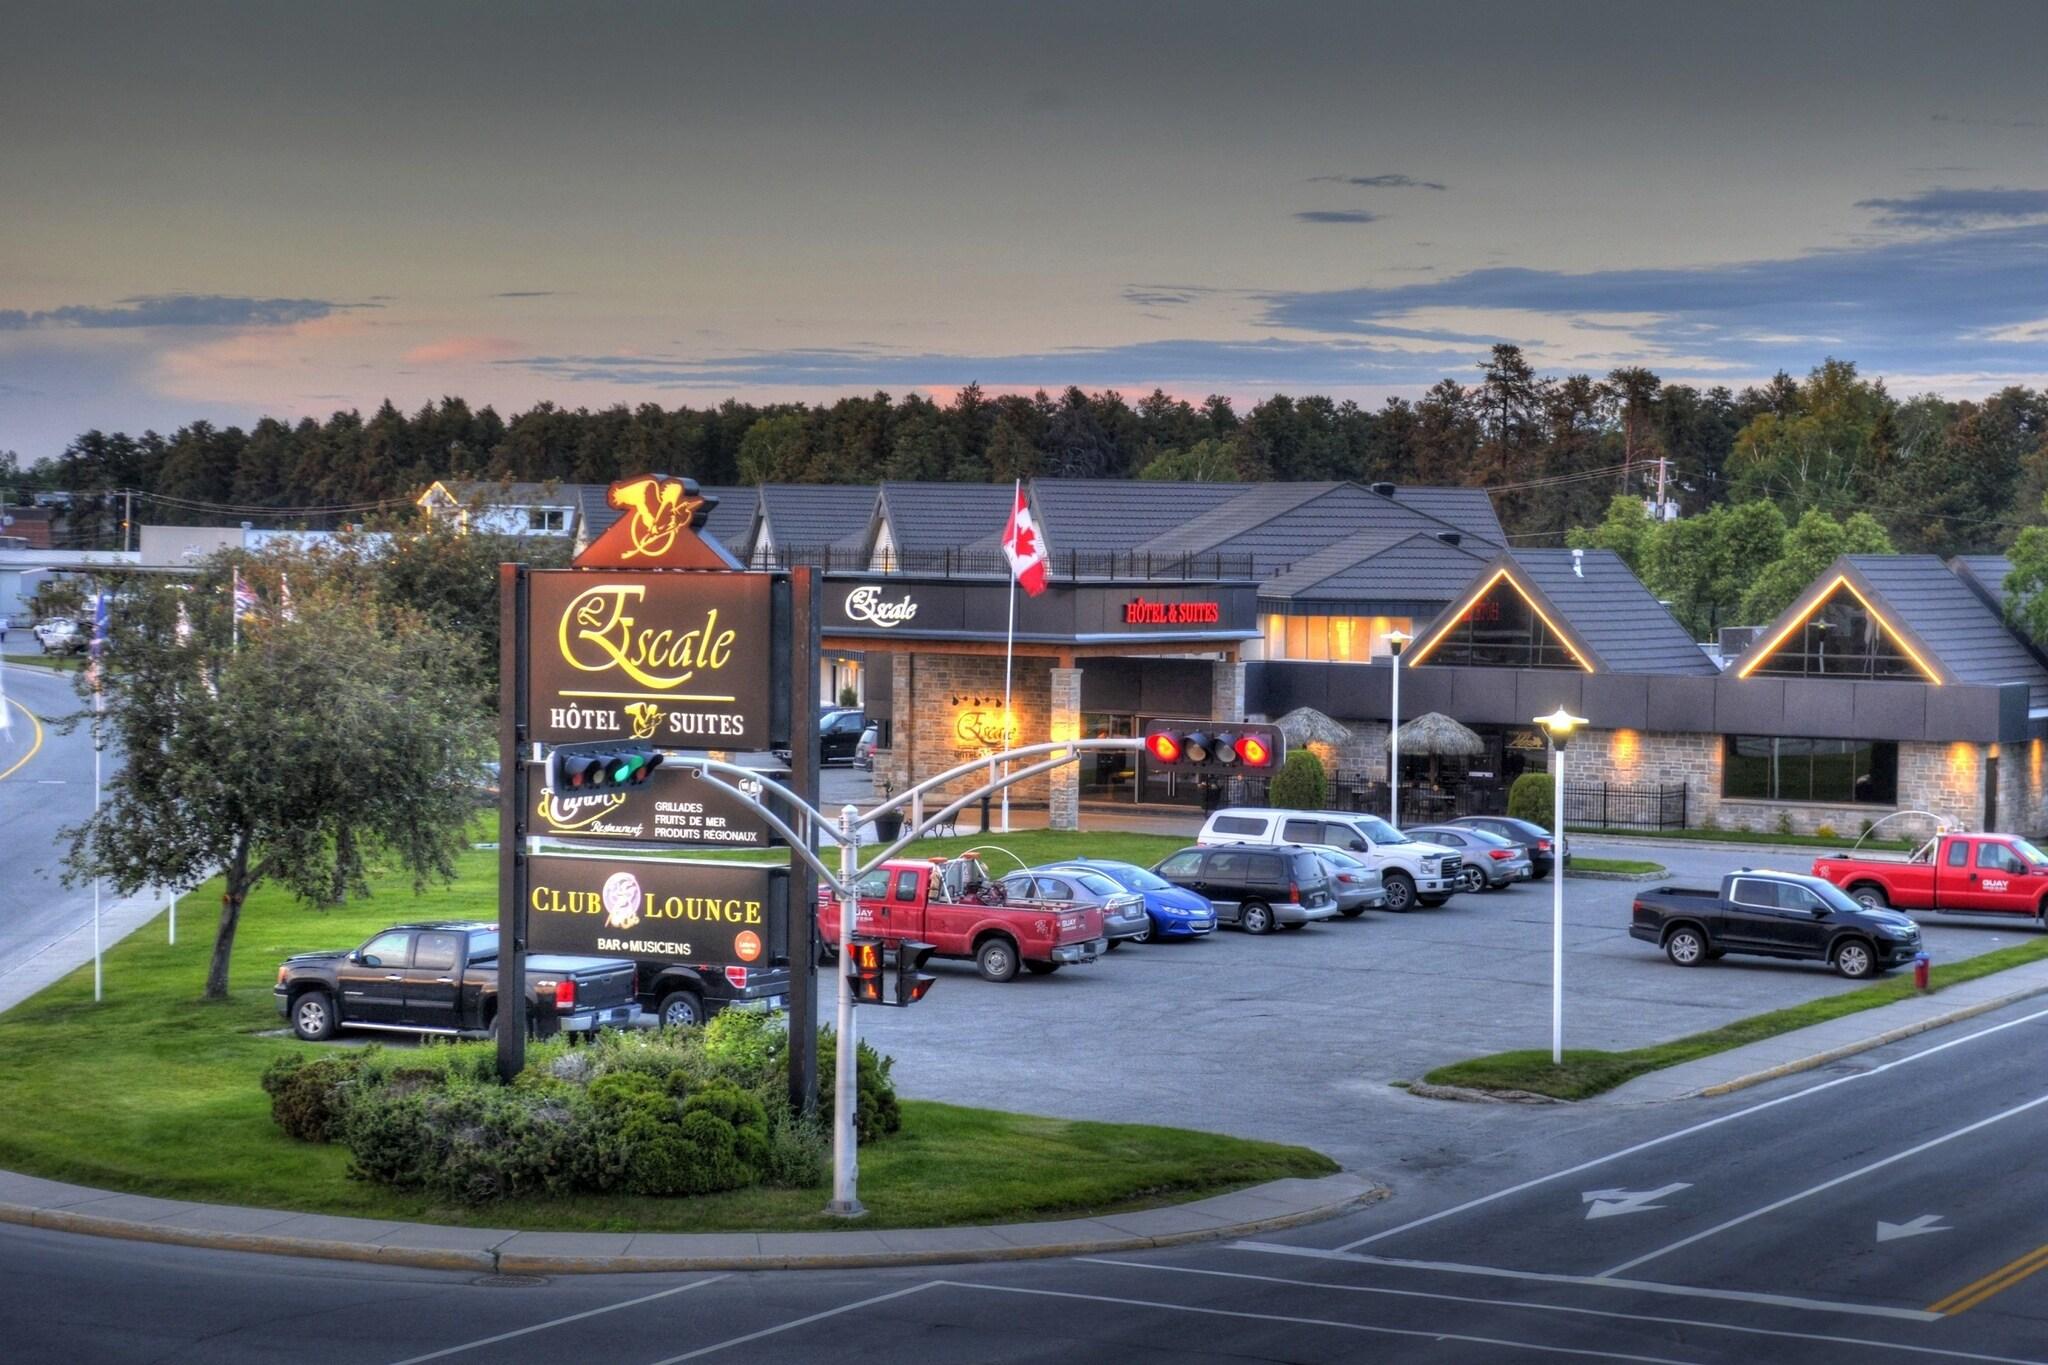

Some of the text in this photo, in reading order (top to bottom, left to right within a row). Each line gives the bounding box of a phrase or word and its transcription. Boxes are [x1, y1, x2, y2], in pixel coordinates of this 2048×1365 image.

[1127, 595, 1219, 623] HÔTEL & SUITES
[550, 702, 744, 736] HÔTEL SUITES
[655, 801, 703, 813] GRILLADES
[590, 820, 645, 837] Restaurant
[655, 815, 726, 827] FRUITS DE MER
[654, 827, 700, 839] PRODUITS
[532, 886, 601, 914] CLUB
[644, 893, 761, 924] LOUNGE
[629, 940, 692, 956] MUSICIENS
